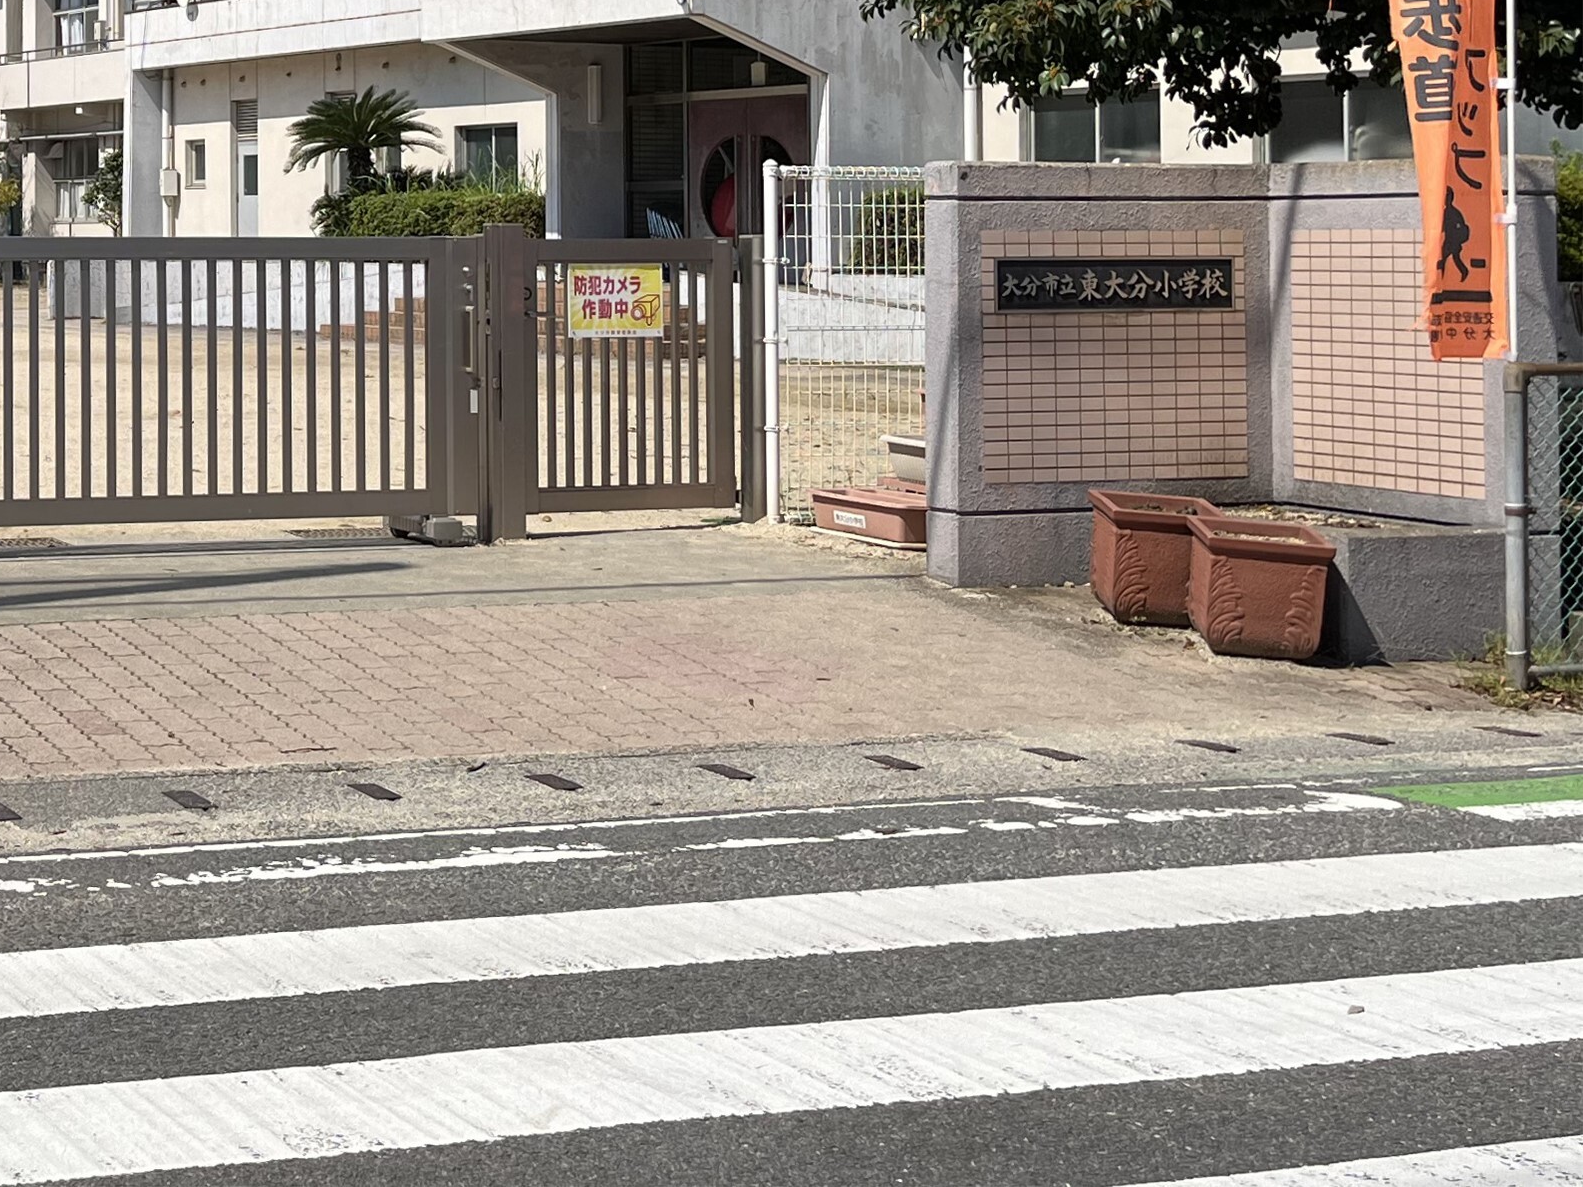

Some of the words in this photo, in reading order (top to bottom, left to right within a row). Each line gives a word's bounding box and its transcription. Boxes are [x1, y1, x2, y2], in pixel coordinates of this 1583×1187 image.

[573, 275, 642, 296] 防犯カメラ
[1001, 268, 1229, 301] 大分市立東大分小学校
[582, 298, 629, 320] 作動中
